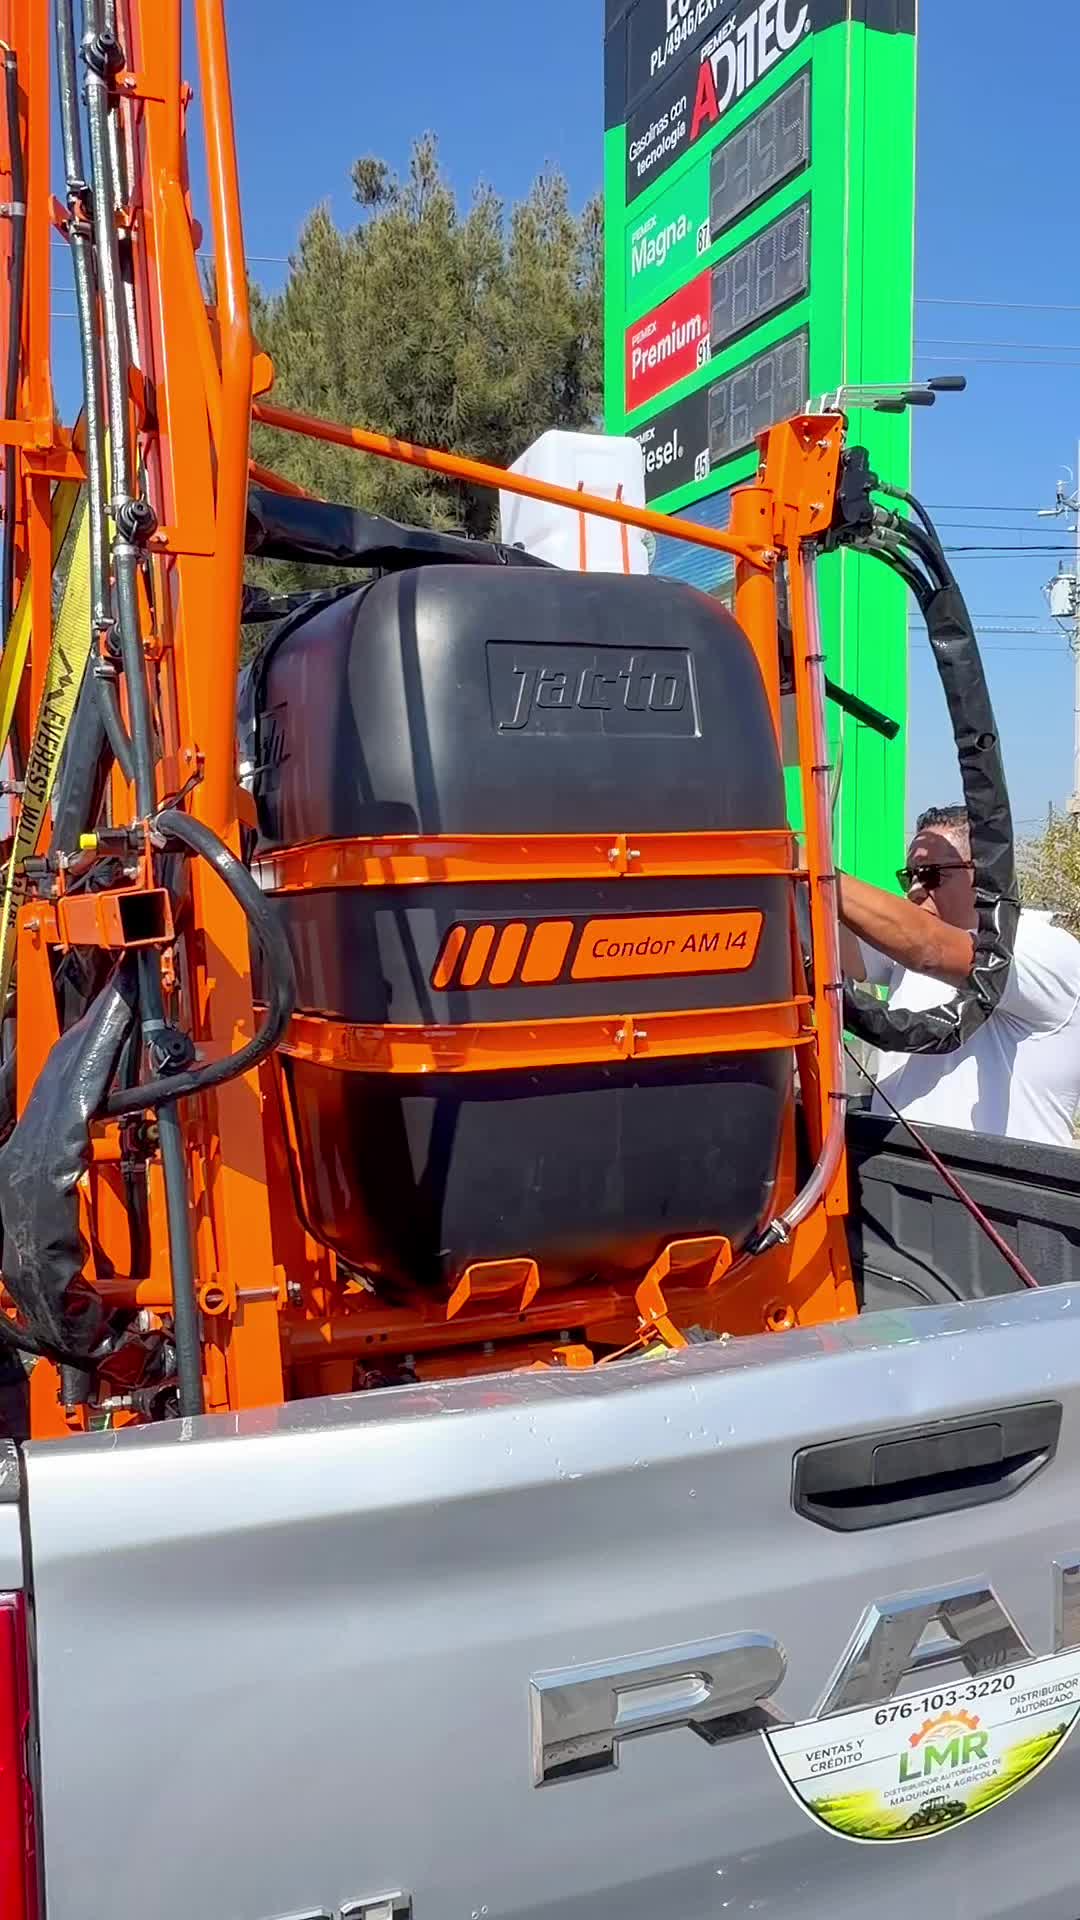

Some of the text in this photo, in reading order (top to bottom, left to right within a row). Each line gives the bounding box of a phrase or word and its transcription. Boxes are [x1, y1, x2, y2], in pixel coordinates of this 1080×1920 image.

[700, 15, 736, 63] PEMEX
[629, 96, 687, 162] Gasolinas con
[632, 214, 687, 278] Magna
[632, 320, 656, 347] PEMEX
[632, 314, 701, 380] Premium
[642, 428, 678, 473] iesel
[25, 707, 66, 802] EVEREST
[592, 931, 748, 958] Condor AM 14
[528, 1552, 1080, 1788] RA
[1009, 1678, 1079, 1706] DISTRIBUIDOR
[874, 1674, 1016, 1726] 676-103-3220
[1015, 1691, 1074, 1715] AUTORIZADO
[805, 1739, 865, 1762] VENTAS Y
[810, 1752, 864, 1774] CRÉDITO
[898, 1730, 990, 1784] LMR
[883, 1776, 940, 1799] DISTRIBUIDOR
[940, 1762, 991, 1782] AUTORIZADO
[889, 1768, 998, 1806] MAQUINARIA AGRÍCOLA
